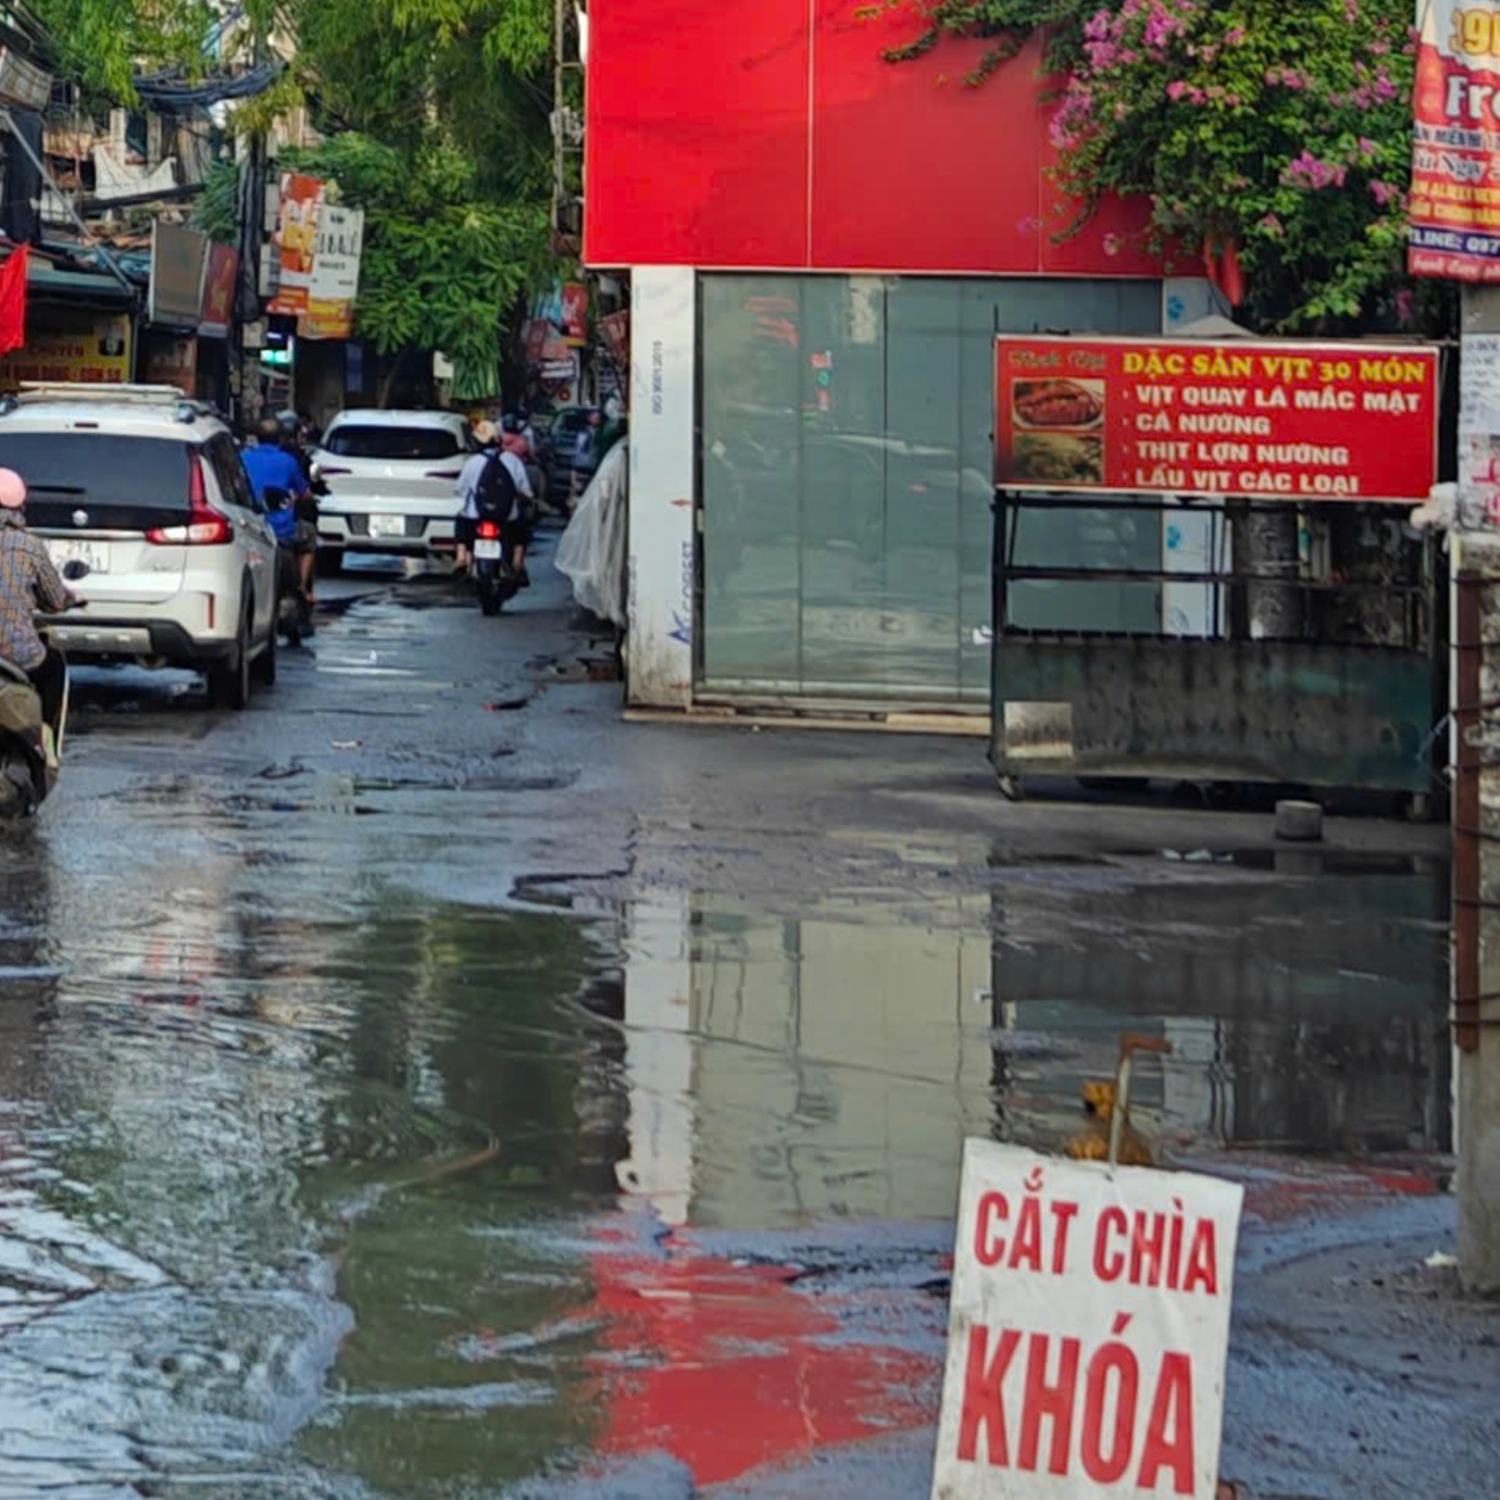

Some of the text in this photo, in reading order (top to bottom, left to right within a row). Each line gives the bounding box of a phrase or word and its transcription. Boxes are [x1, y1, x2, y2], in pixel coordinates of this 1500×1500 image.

[1122, 347, 1186, 380] ĐẶC
[1192, 346, 1252, 377] SẢN
[1261, 356, 1313, 384] VỊT
[1319, 361, 1351, 382] 30
[1359, 355, 1426, 383] MÓN
[1135, 384, 1175, 408] VỊT
[1181, 385, 1247, 407] QUAY
[1135, 410, 1171, 432] CÁ
[1135, 440, 1191, 464] THỊT
[1192, 470, 1233, 492] VỊT
[1238, 468, 1292, 491] CÁC
[1299, 473, 1360, 498] LOẠI
[972, 1166, 1219, 1297] CẮT CHÌA
[956, 1311, 1196, 1496] KHÓA
